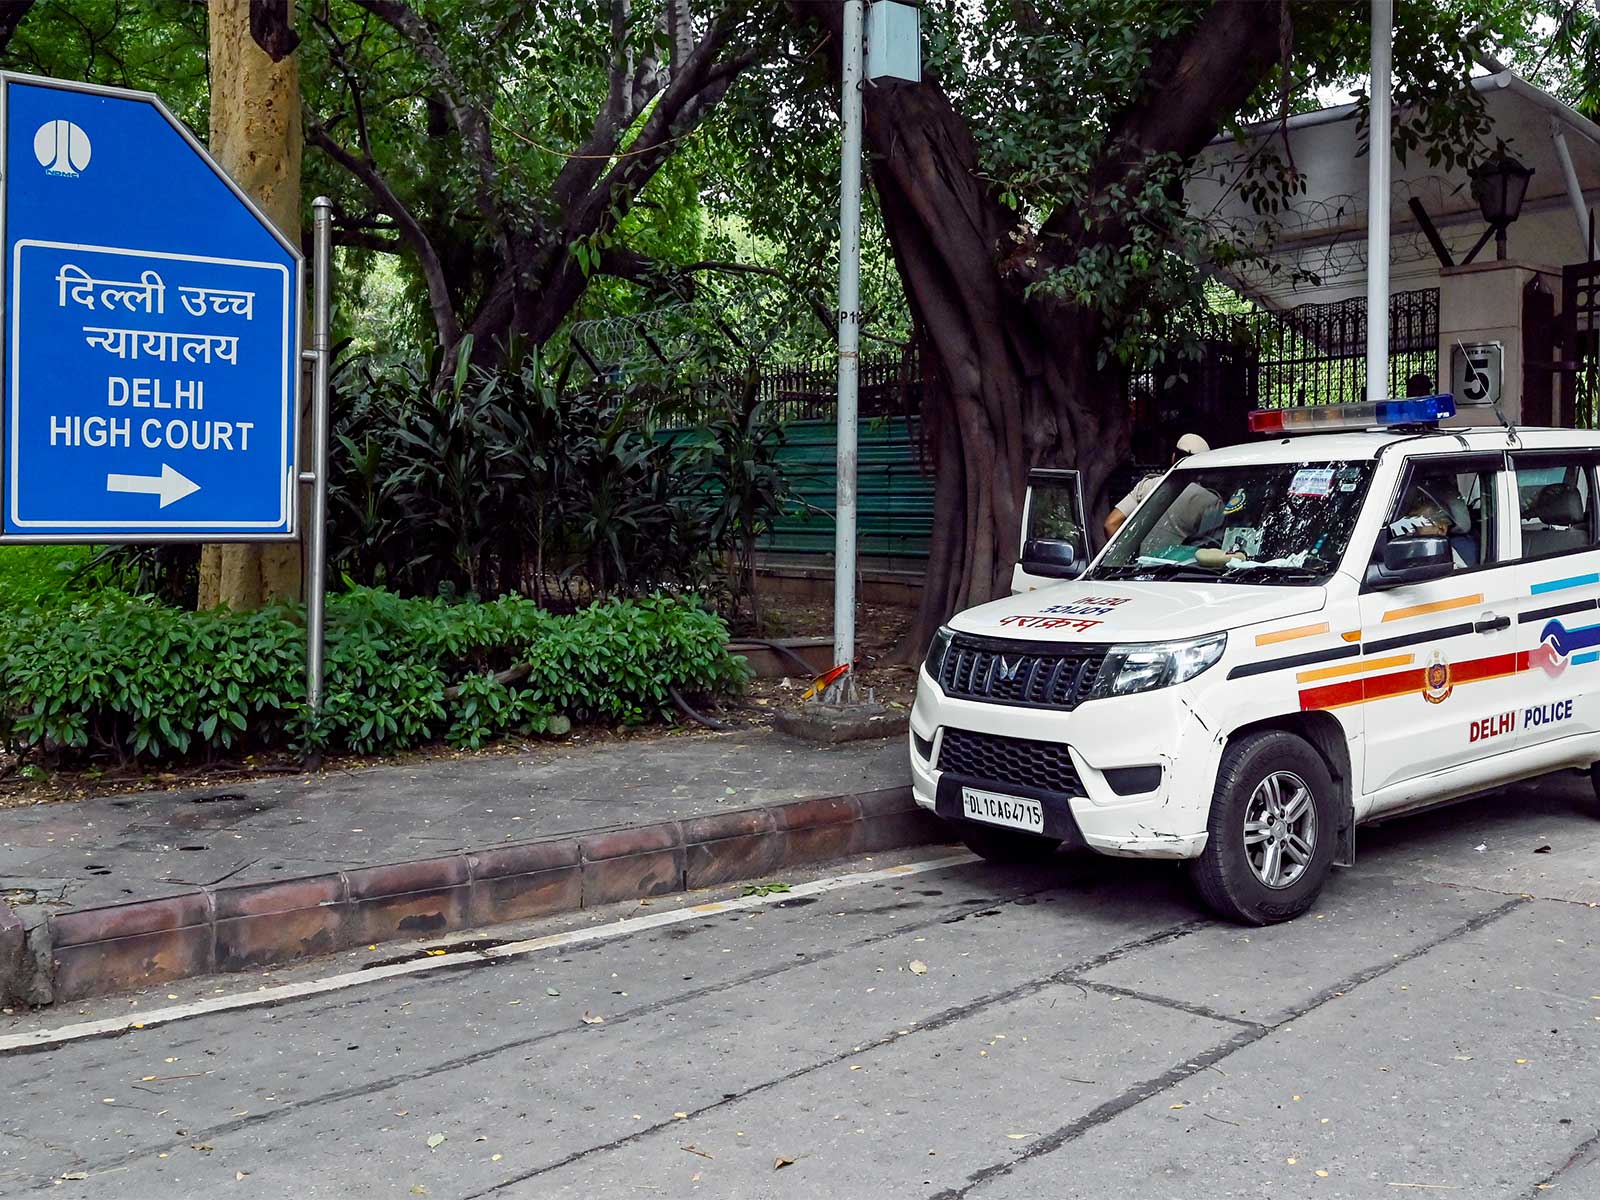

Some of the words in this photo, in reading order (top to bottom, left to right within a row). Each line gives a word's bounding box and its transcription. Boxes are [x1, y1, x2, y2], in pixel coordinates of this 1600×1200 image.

[55, 264, 166, 314] दिल्ली
[178, 286, 256, 320] उच्च
[82, 326, 239, 365] न्यायालय
[108, 376, 204, 410] DELHI
[1463, 359, 1490, 400] 5
[50, 416, 131, 448] HIGH
[141, 418, 254, 450] COURT
[1000, 615, 1104, 633] पराक्रम
[1469, 711, 1516, 743] DELHI
[1524, 699, 1573, 729] POLICE
[970, 795, 1041, 824] DL1CAG4715
